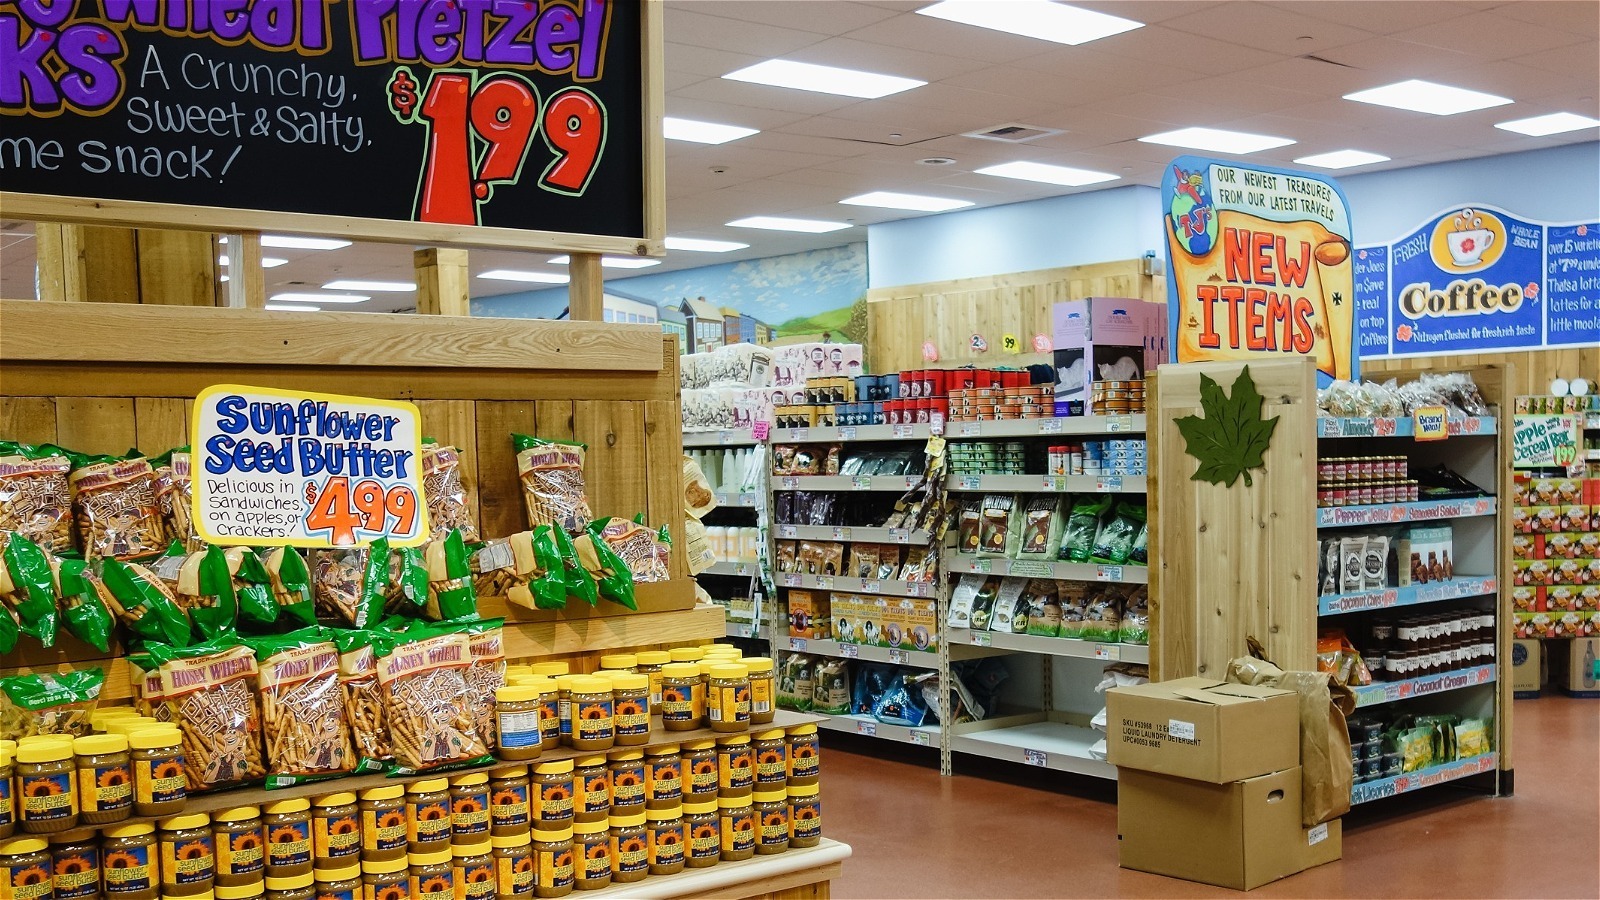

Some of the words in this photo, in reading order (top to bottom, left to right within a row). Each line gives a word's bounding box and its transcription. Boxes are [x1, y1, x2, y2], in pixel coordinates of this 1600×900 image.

[140, 44, 170, 91] A
[181, 52, 358, 108] Crunchy,
[126, 96, 246, 138] Sweet
[249, 107, 271, 137] &
[276, 105, 372, 153] Salty,
[1217, 168, 1236, 184] OUR
[1244, 172, 1277, 191] NEWEST
[1286, 178, 1332, 202] TREASURES
[1219, 188, 1243, 204] FROM
[1248, 192, 1266, 208] OUR
[1270, 196, 1298, 211] LATEST
[1300, 198, 1335, 222] TRAVELS
[1510, 224, 1541, 240] WHOLE
[1393, 233, 1429, 266] FRESH
[1512, 237, 1539, 249] BEAN
[1549, 243, 1564, 255] over
[1224, 227, 1311, 288] NEW
[1362, 296, 1380, 310] real
[1401, 281, 1521, 316] Coffee
[1551, 298, 1579, 312] lattes
[1581, 296, 1592, 310] for
[1197, 285, 1315, 353] ITEMS
[1360, 319, 1370, 329] on
[1371, 315, 1385, 329] top
[1551, 318, 1572, 332] little
[1471, 326, 1482, 338] for
[1516, 324, 1536, 336] taste
[216, 395, 400, 441] Sunflower
[1419, 414, 1443, 425] Brand
[1343, 419, 1374, 436] Almonds
[1549, 430, 1569, 447] Bar
[205, 434, 294, 475] Seed
[298, 437, 413, 479] Butter
[207, 478, 275, 495] Delicious
[280, 479, 294, 494] in
[209, 511, 231, 521] on
[1335, 508, 1367, 523] Pepper
[427, 645, 462, 665] WHEAT
[171, 666, 207, 688] HONEY
[209, 655, 253, 679] WHEAT
[1122, 719, 1134, 727] SKU
[1156, 724, 1162, 732] 12
[1122, 727, 1140, 737] LIQUID
[1141, 731, 1167, 742] LAUNDRY
[1168, 734, 1201, 747] DETERGENT
[27, 795, 67, 805] sunflower
[273, 840, 307, 850] sunflower
[58, 869, 98, 881] sunflower
[108, 866, 144, 876] sunflower
